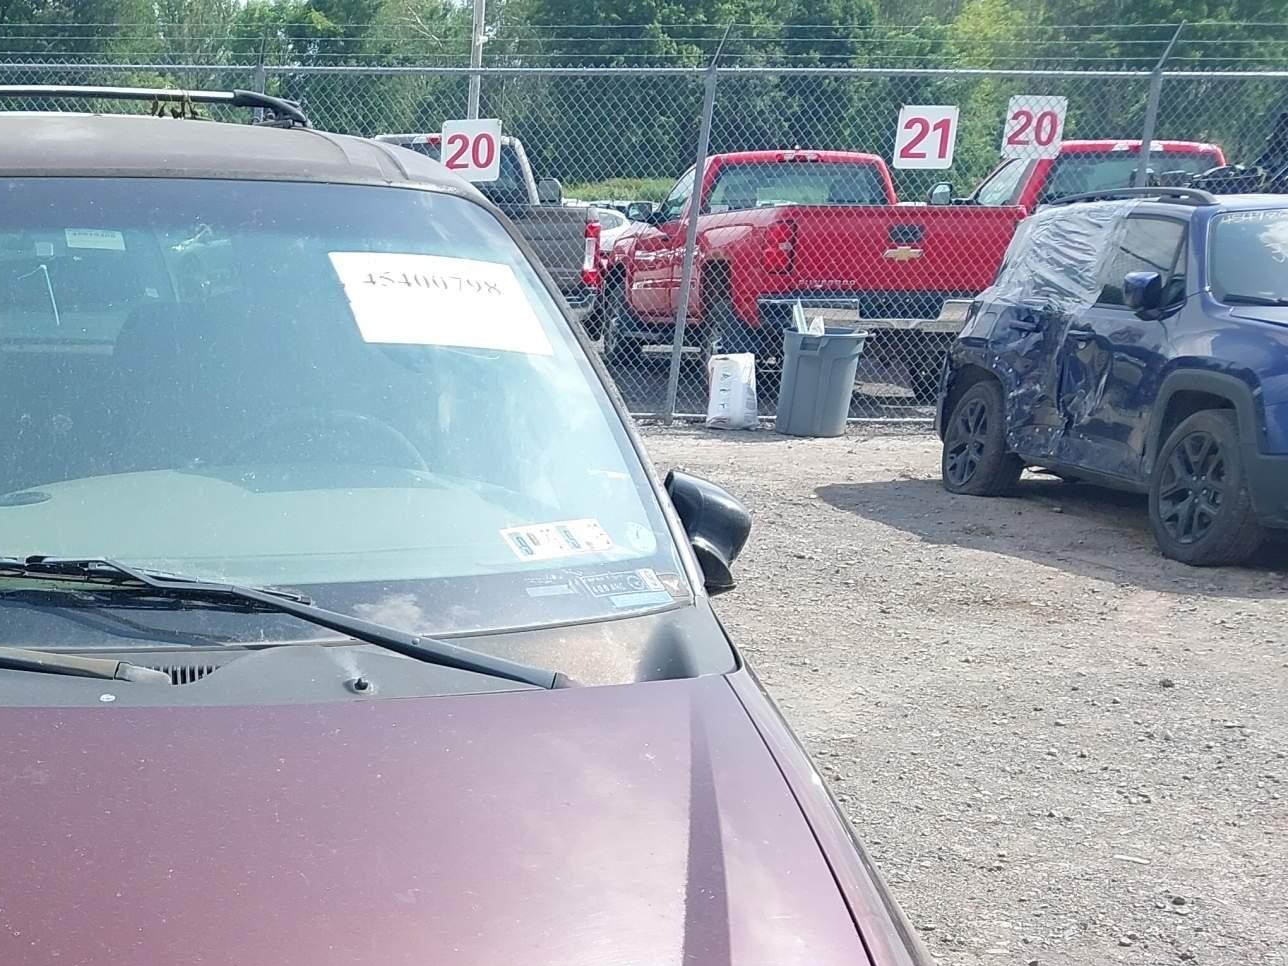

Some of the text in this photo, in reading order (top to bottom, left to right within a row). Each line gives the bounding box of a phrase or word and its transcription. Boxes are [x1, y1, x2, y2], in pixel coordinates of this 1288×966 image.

[899, 117, 951, 159] 21
[1007, 110, 1058, 146] 20
[445, 133, 495, 169] 20
